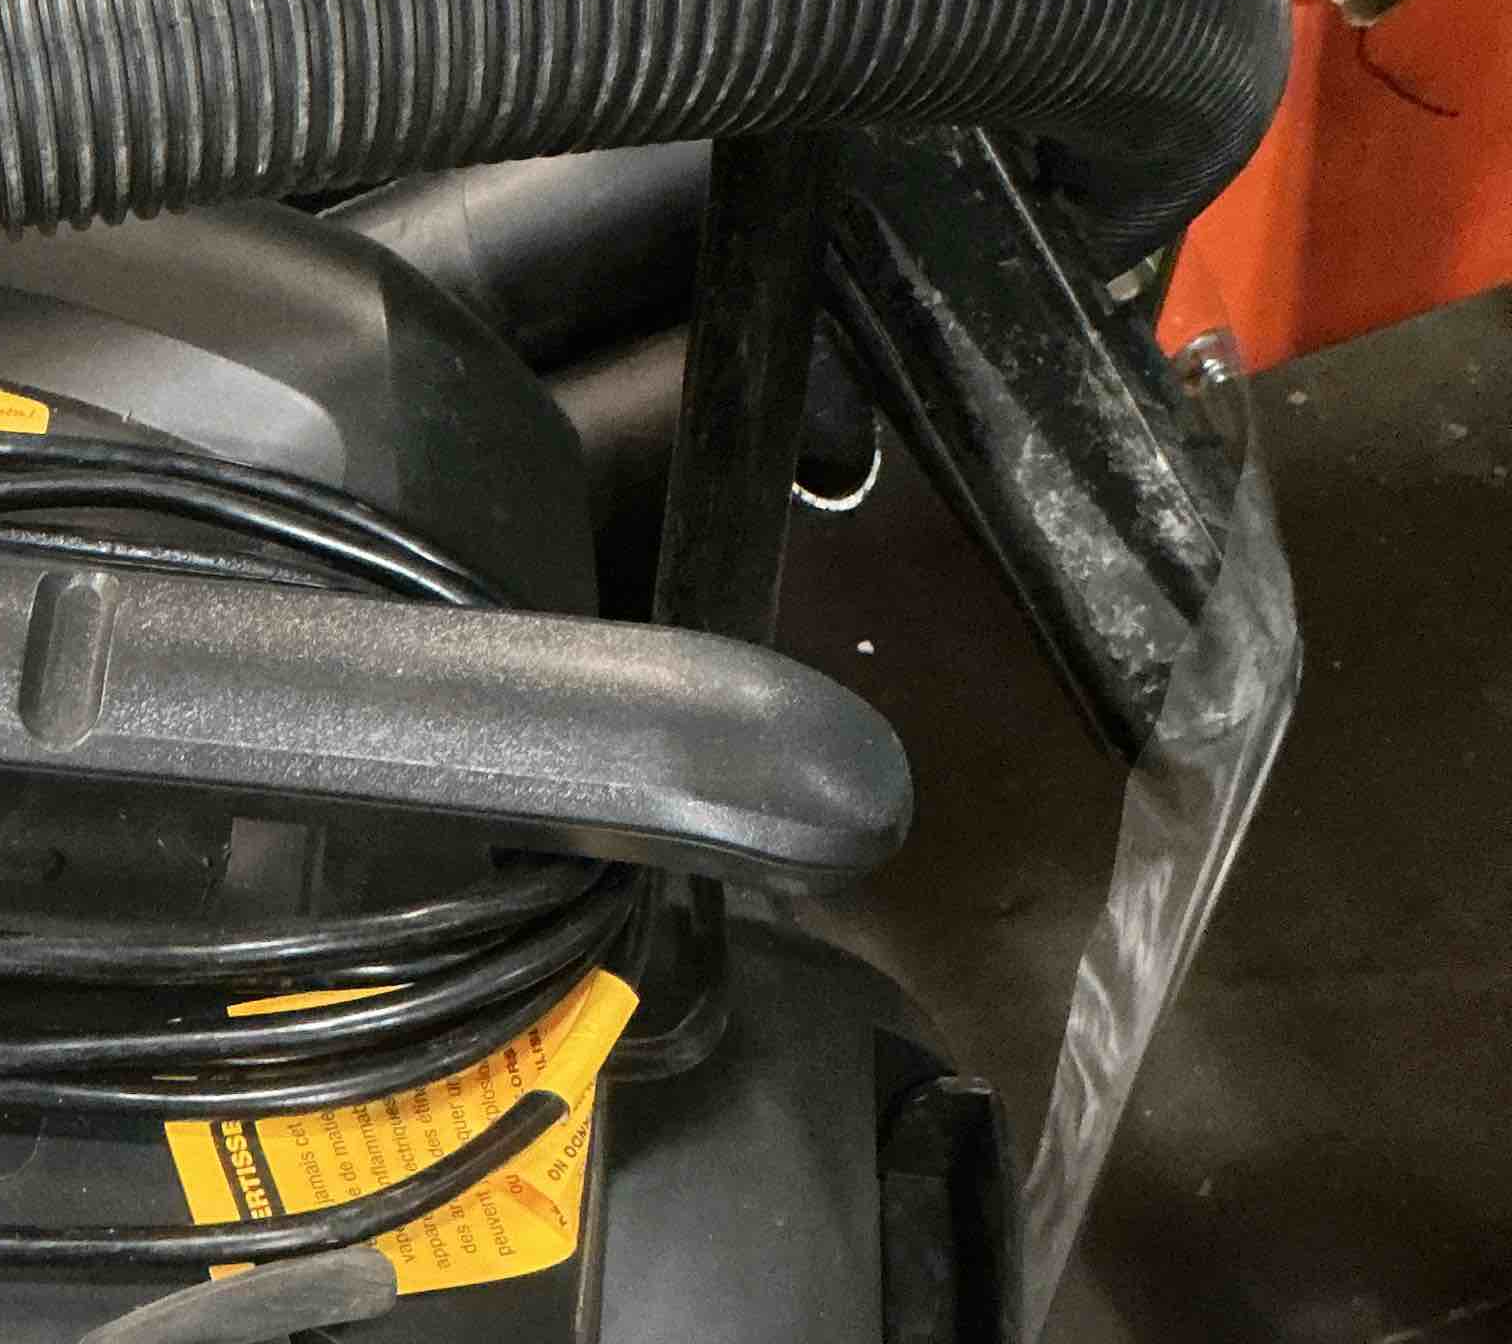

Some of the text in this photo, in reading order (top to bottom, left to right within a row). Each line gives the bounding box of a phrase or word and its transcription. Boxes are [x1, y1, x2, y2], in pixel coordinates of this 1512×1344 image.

[220, 1119, 274, 1219] ERTISSE
[352, 1103, 391, 1188] nflammab
[385, 1096, 418, 1173] ectriques
